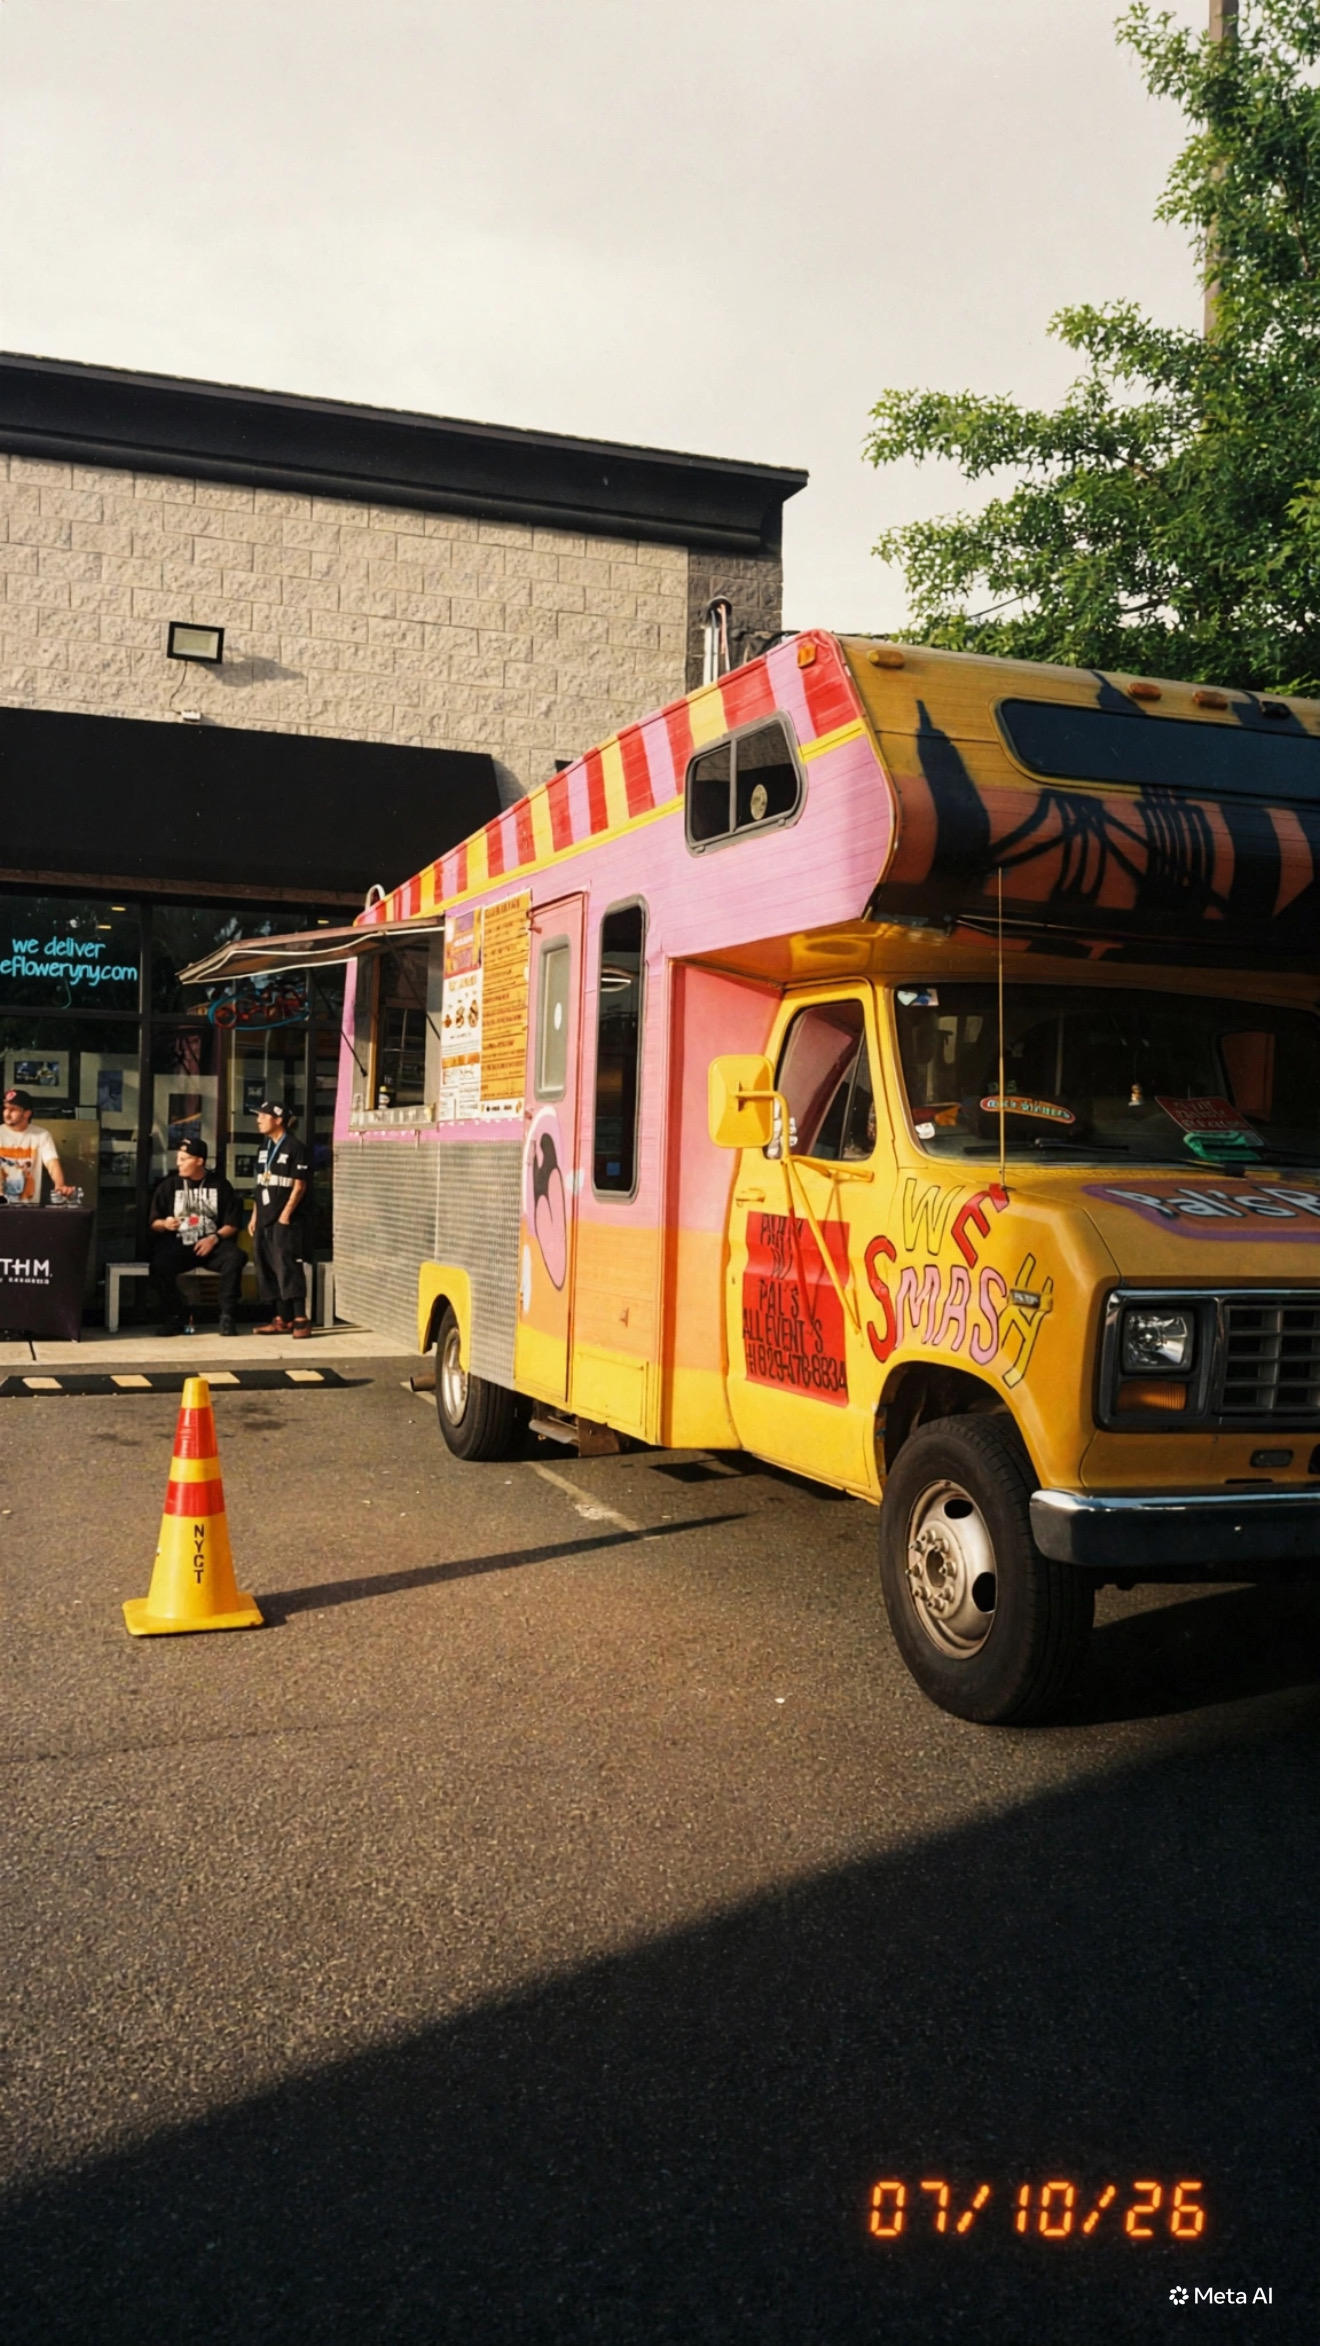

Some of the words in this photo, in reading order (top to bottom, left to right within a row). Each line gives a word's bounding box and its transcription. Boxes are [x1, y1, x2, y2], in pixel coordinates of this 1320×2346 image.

[12, 938, 39, 953] we
[44, 936, 106, 959] deliver
[903, 1178, 1010, 1270] WE
[1104, 1187, 1298, 1220] Pal's
[743, 1308, 763, 1342] ALL
[864, 1235, 1054, 1389] SMASH
[193, 1524, 205, 1584] NYCT
